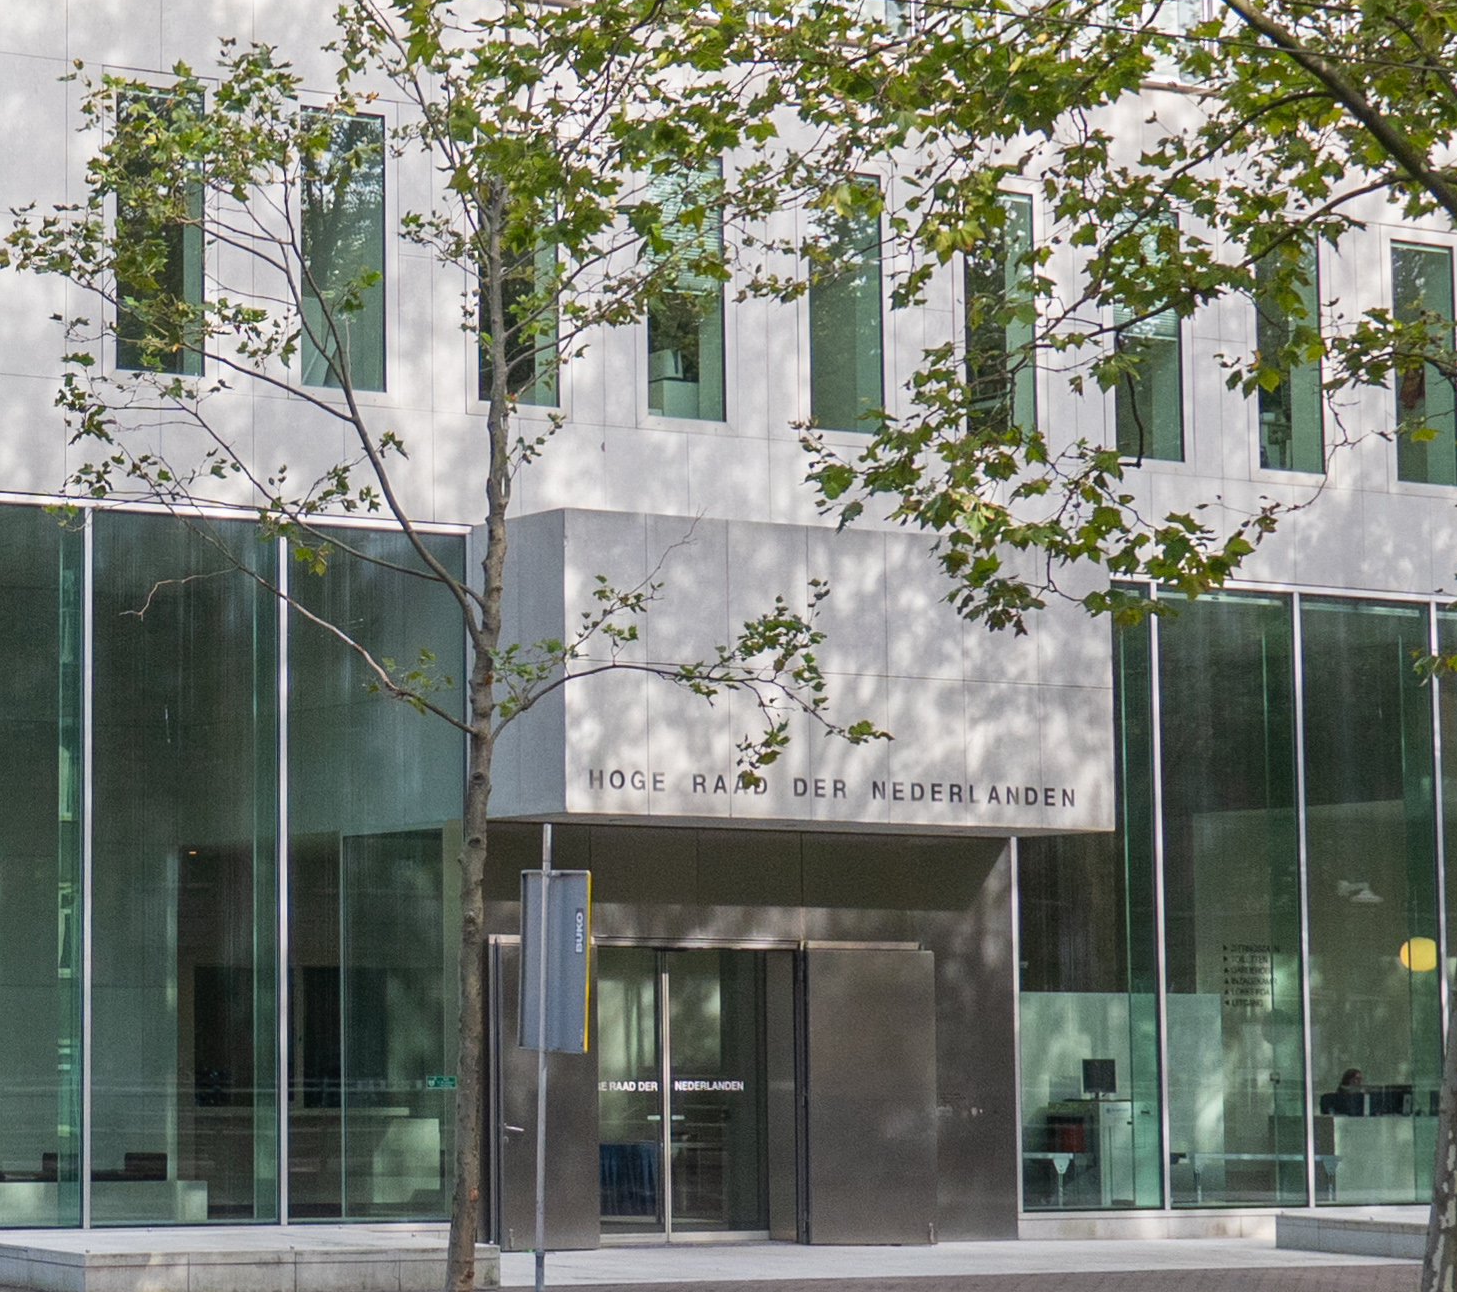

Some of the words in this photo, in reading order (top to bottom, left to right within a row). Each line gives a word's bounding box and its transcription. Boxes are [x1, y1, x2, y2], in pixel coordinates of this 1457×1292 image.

[588, 769, 666, 792] HOGE
[793, 777, 847, 799] DER
[872, 780, 1076, 807] NEDERLANDEN
[575, 912, 584, 954] BUKO
[609, 1081, 636, 1092] RAAD
[637, 1081, 659, 1092] DER
[674, 1081, 745, 1092] NEDERLANDEN
